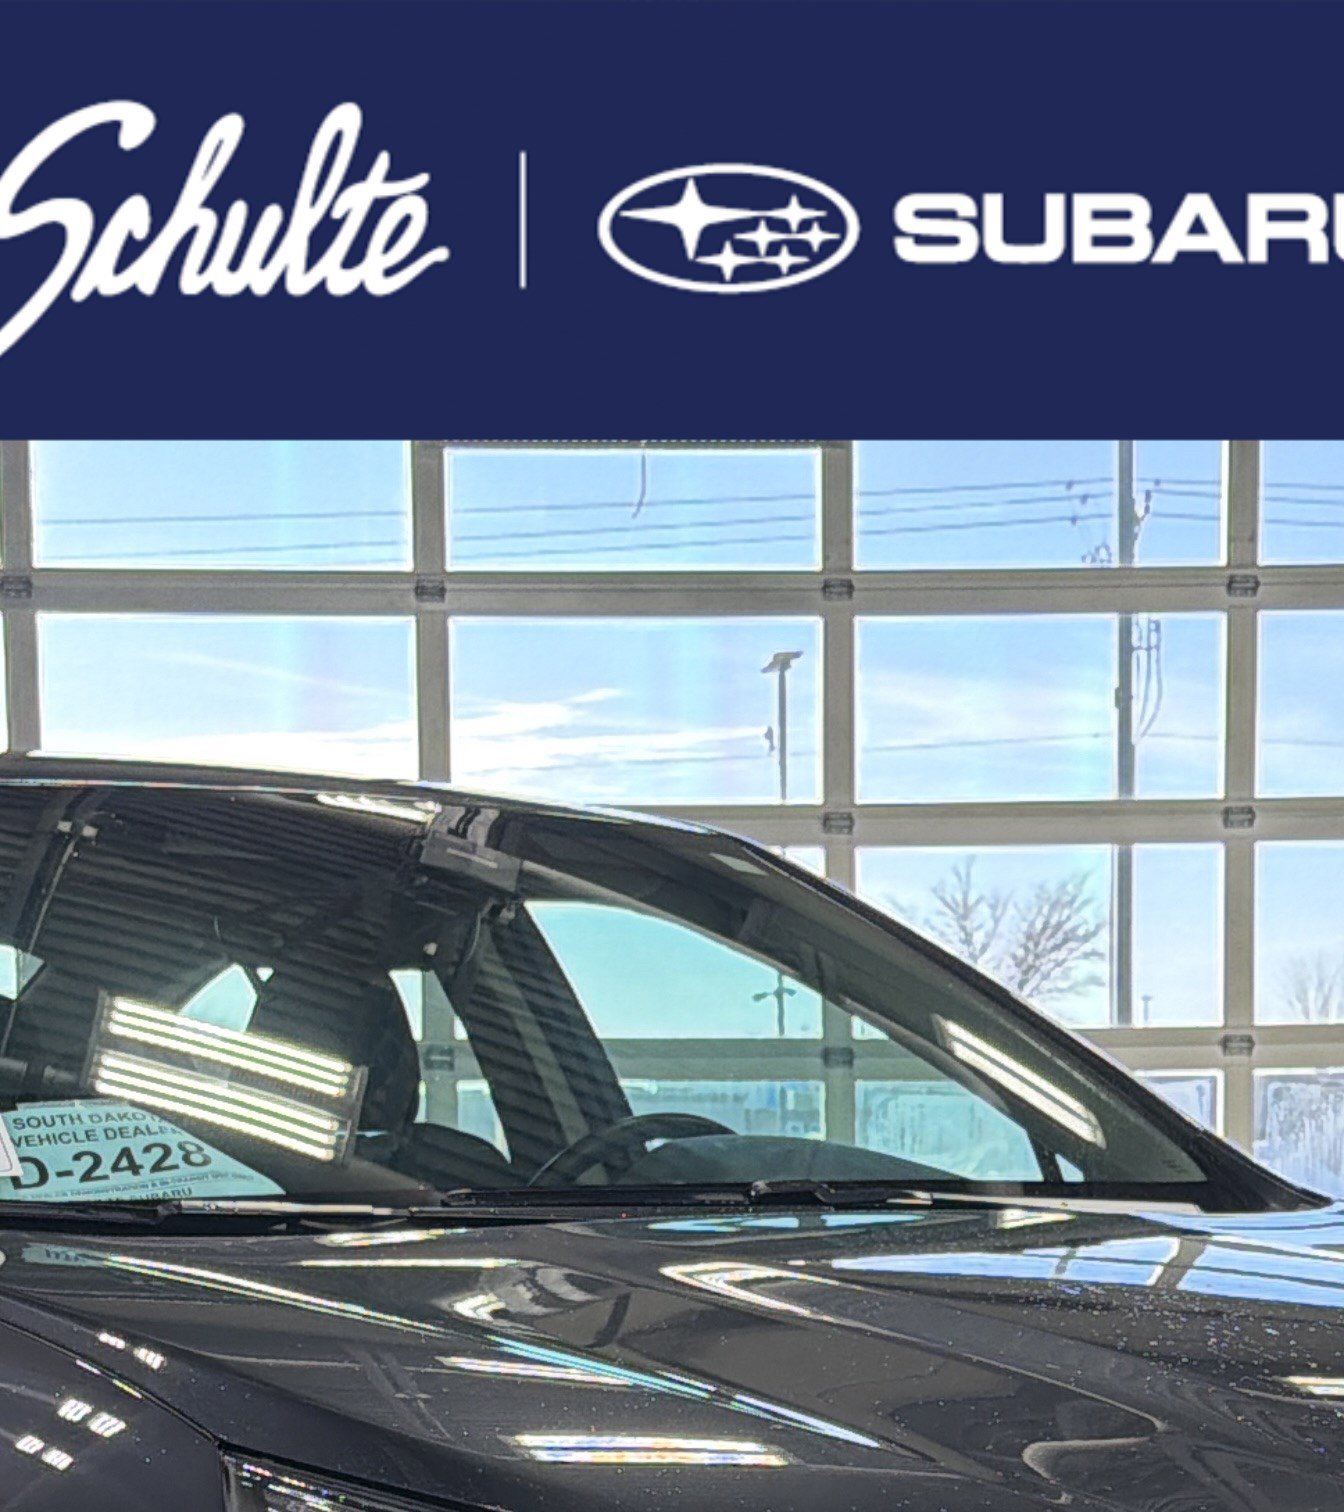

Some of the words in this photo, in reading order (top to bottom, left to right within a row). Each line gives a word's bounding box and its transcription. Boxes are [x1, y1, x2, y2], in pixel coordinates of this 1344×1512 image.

[12, 1113, 84, 1130] SOUTH
[88, 1111, 165, 1124] DAKOT
[10, 1128, 100, 1149] VEHICLE
[10, 1139, 213, 1191] D-2428
